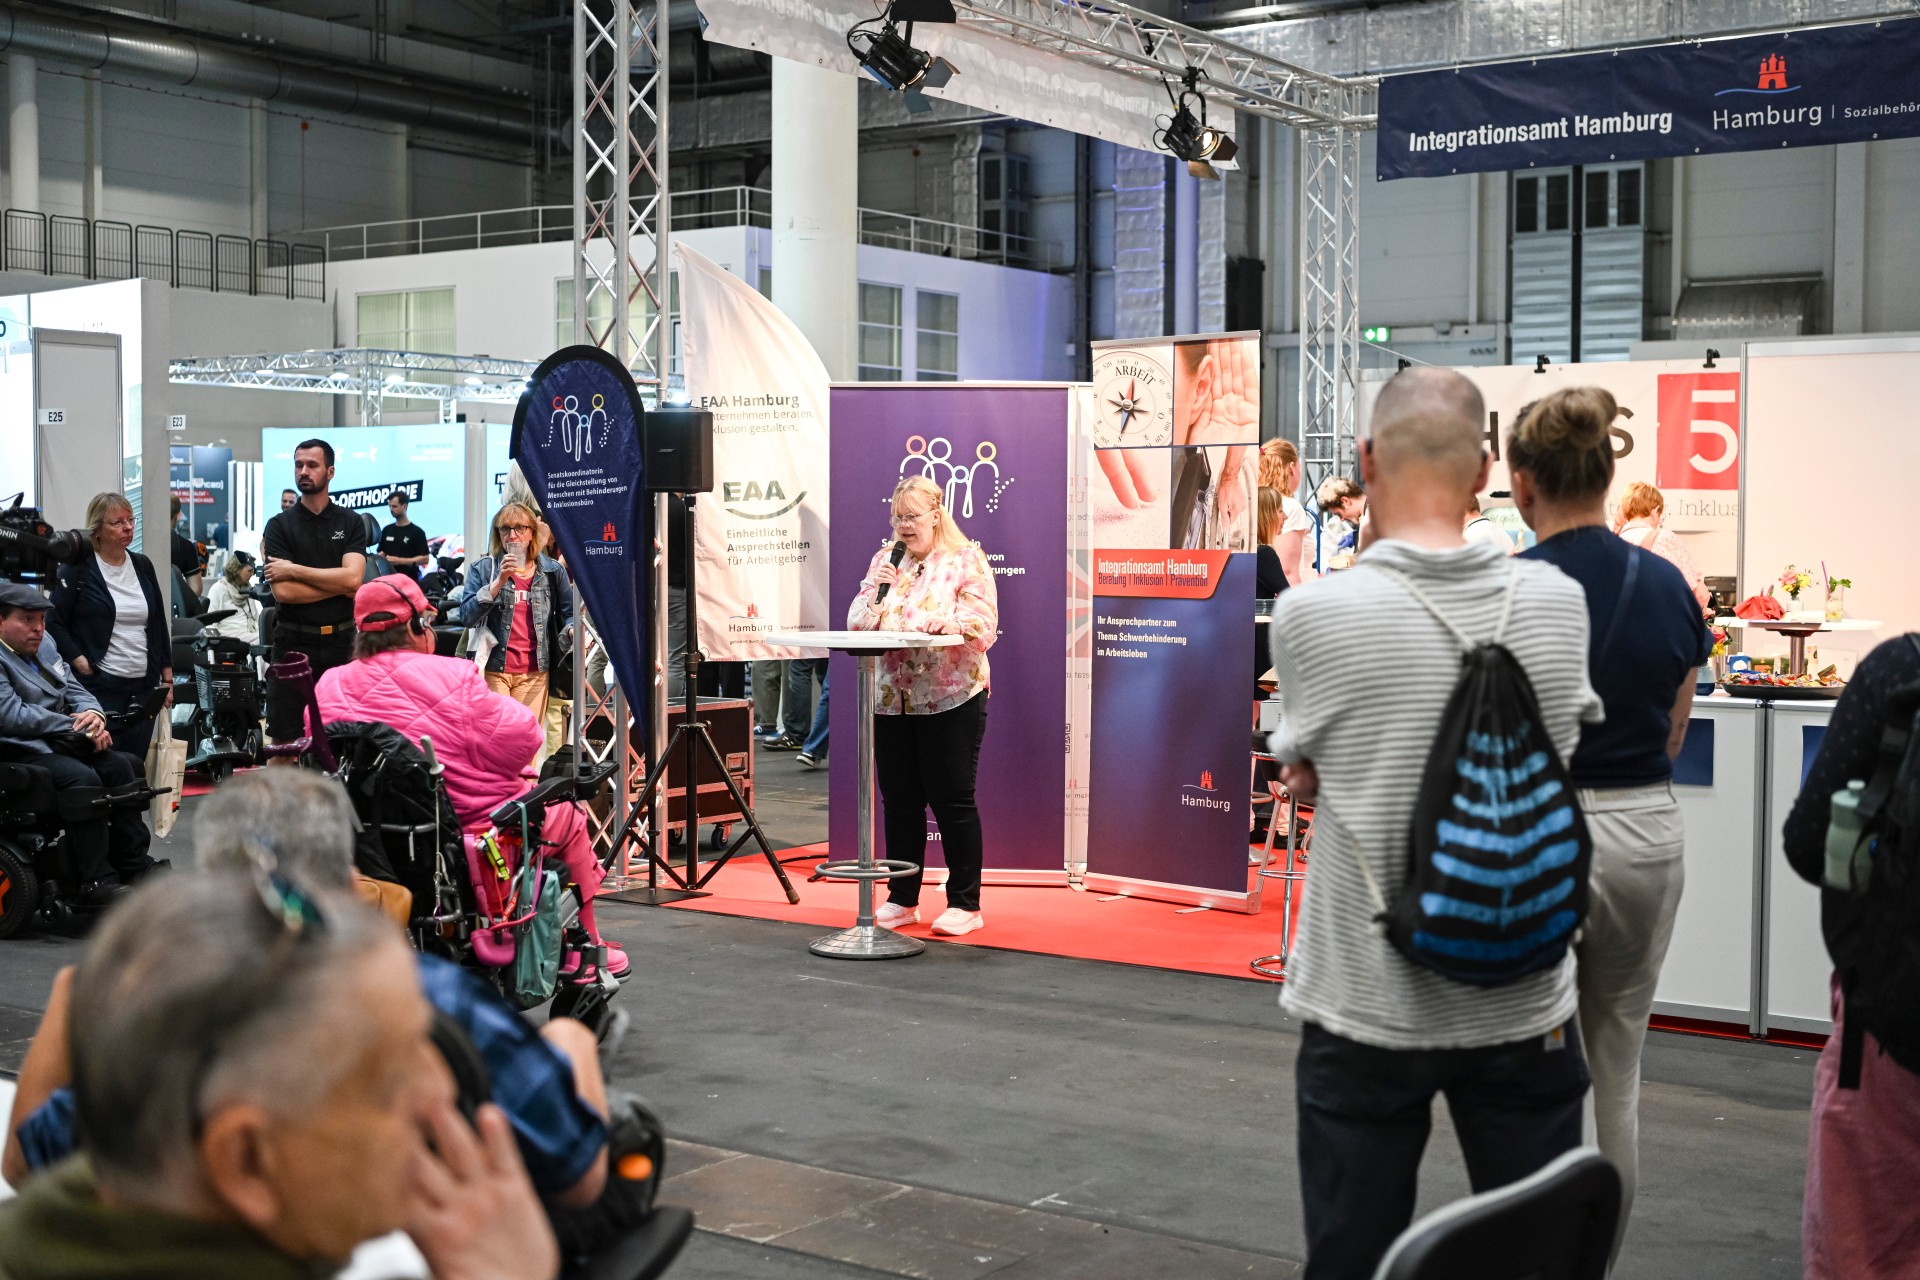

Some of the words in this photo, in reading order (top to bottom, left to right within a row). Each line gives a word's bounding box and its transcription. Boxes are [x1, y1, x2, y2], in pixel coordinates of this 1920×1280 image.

[1713, 104, 1822, 130] Hamburg
[1409, 116, 1568, 153] Integrationsamt
[1574, 111, 1673, 137] Hamburg
[1115, 365, 1157, 385] ARBEIT
[701, 395, 729, 408] EAA
[733, 394, 800, 408] Hamburg
[48, 411, 63, 422] E25
[172, 416, 183, 427] E23
[547, 467, 604, 479] Senatskoordinatorin
[565, 478, 607, 487] Gleichstellung
[547, 490, 575, 499] Menschen
[575, 489, 586, 497] mit
[586, 485, 628, 496] Behinderungen
[723, 480, 786, 502] EAA
[553, 499, 594, 508] Inklusionsbüro
[727, 528, 788, 539] Einheitliche
[585, 546, 623, 555] Hamburg
[727, 540, 811, 553] Ansprechstellen
[727, 556, 742, 566] für
[746, 554, 807, 566] Arbeitgeber
[1098, 558, 1165, 577] Integrationsamt
[1167, 558, 1208, 579] Hamburg
[1133, 573, 1164, 586] Inklusion
[1097, 615, 1106, 624] Ihr
[1106, 616, 1162, 628] Ansprechpartner
[1163, 619, 1177, 627] zum
[728, 624, 773, 633] Hamburg
[1097, 631, 1118, 641] Thema
[1119, 632, 1187, 646] Schwerbehinderung
[1097, 647, 1104, 656] im
[1105, 647, 1148, 659] Arbeitsleben
[1181, 794, 1230, 812] Hamburg
